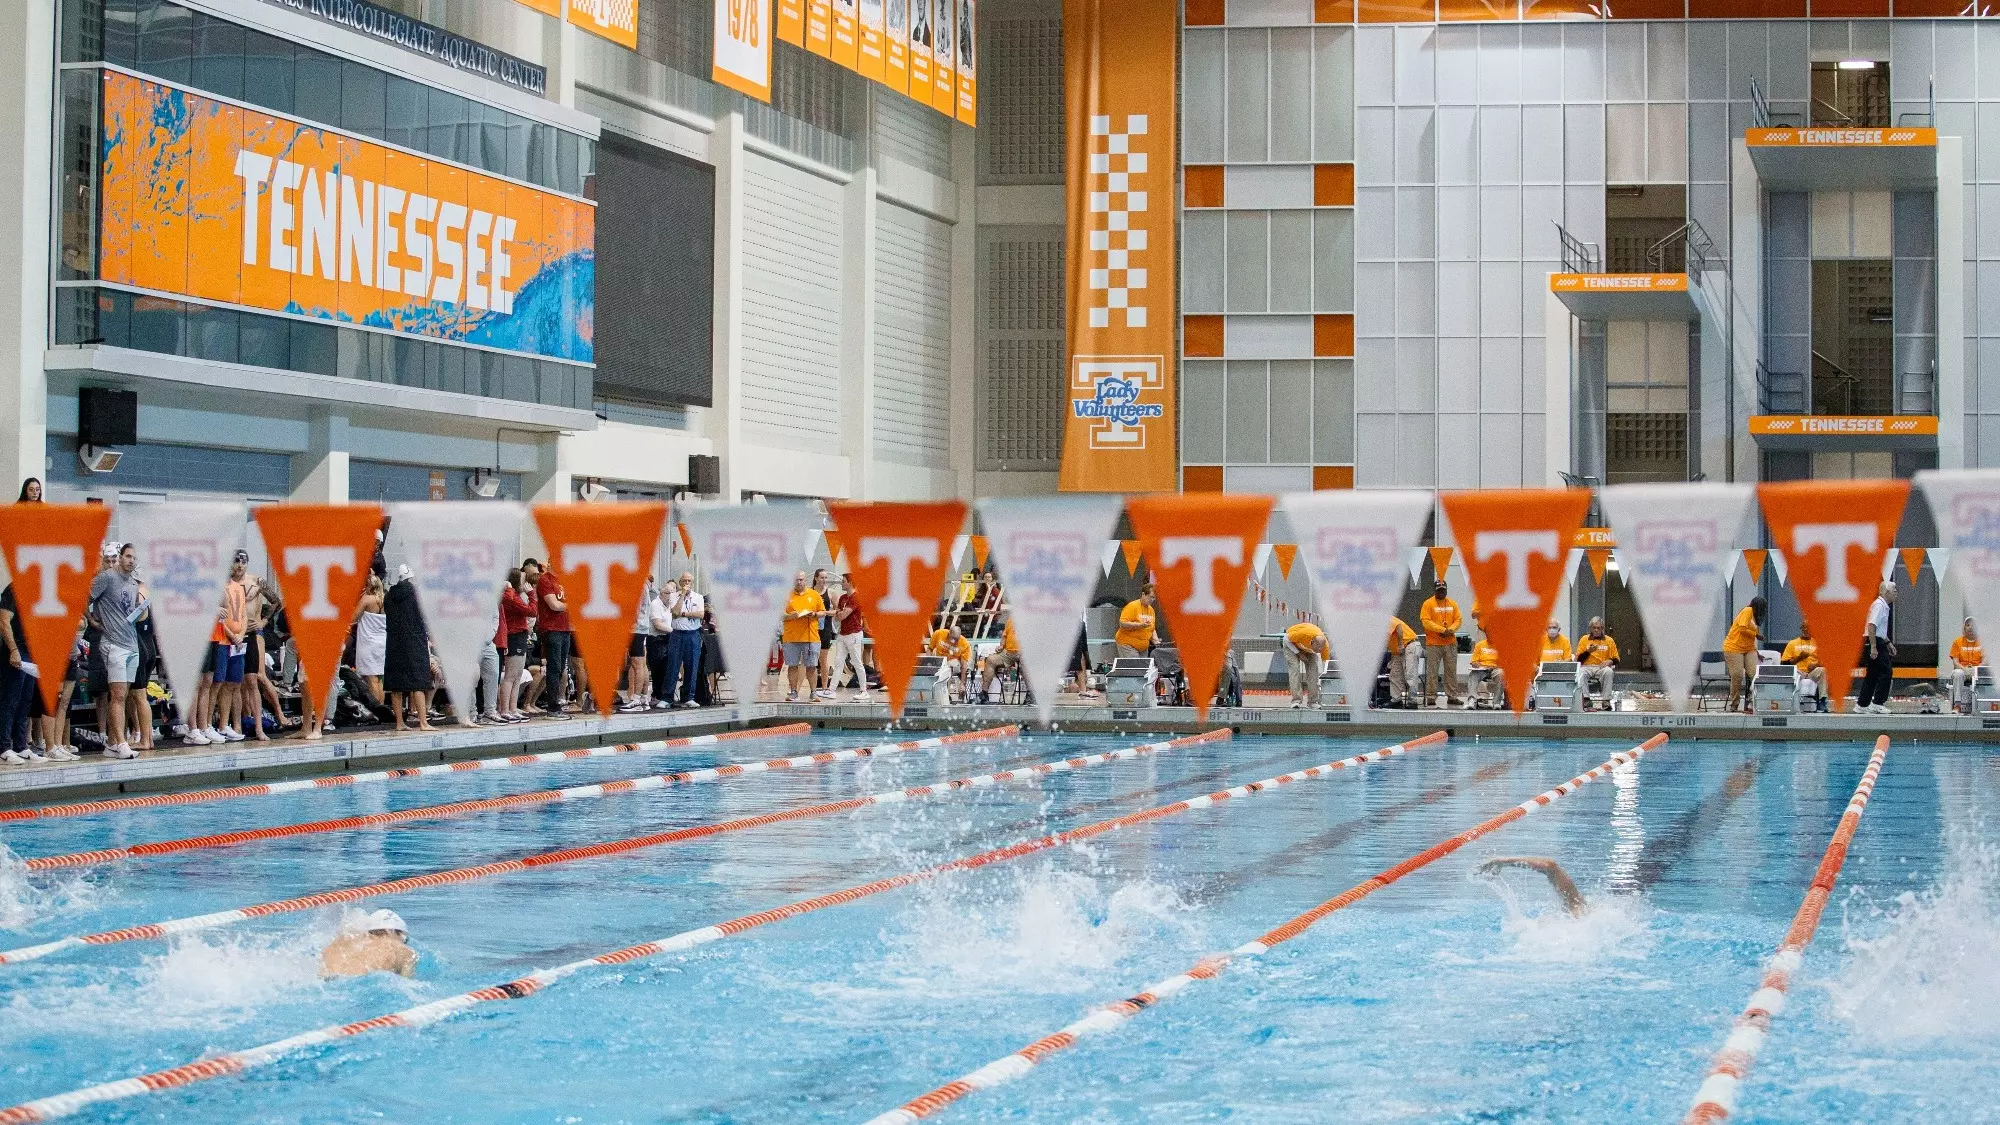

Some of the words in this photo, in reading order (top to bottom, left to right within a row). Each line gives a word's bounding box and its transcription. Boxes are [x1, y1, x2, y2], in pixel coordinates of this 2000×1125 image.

[310, 0, 435, 55] INTERCOLLEGIATE
[439, 35, 497, 76] AQUATIC
[500, 57, 544, 94] CENTER
[727, 0, 759, 48] 1978
[1798, 130, 1883, 143] TENNESSEE
[234, 149, 517, 315] TENNESSEE
[1583, 277, 1651, 288] TENNESSEE
[1073, 398, 1162, 426] Volunteers
[1096, 377, 1139, 403] Lady
[1800, 419, 1885, 431] TENNESSEE
[15, 545, 85, 617] T
[284, 546, 356, 620] T
[561, 543, 640, 619] T
[859, 536, 940, 613] T
[1160, 535, 1244, 615] T
[1474, 530, 1559, 609] T
[1792, 522, 1878, 603] T
